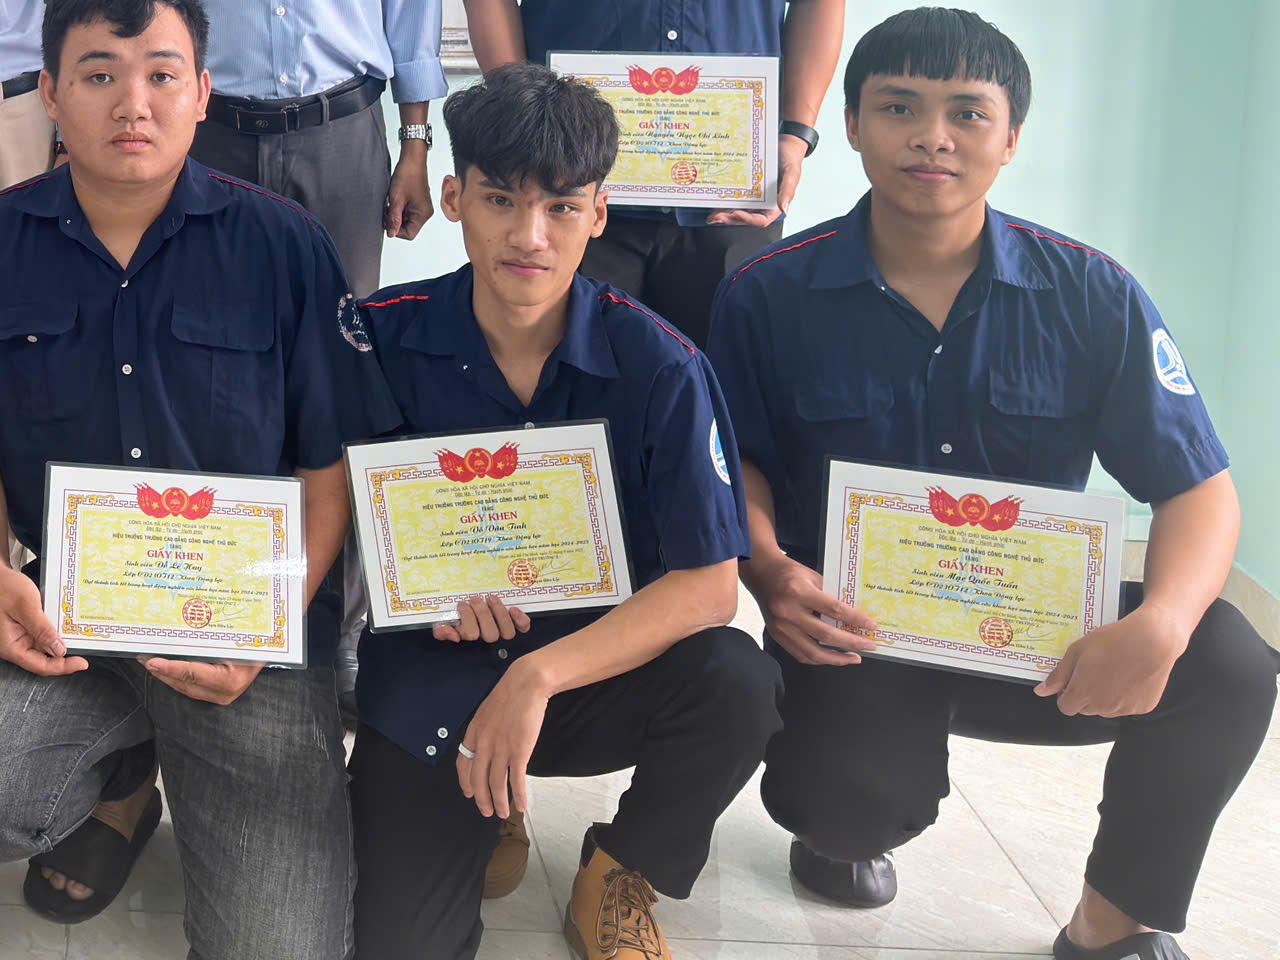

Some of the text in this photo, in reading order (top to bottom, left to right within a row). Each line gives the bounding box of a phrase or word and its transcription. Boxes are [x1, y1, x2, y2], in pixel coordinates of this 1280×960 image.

[639, 120, 690, 130] GIẤY KHEN
[460, 511, 518, 524] GIẤY KHEN
[147, 546, 204, 561] GIẤY KHEN
[938, 558, 1005, 577] GIẤY KHEN
